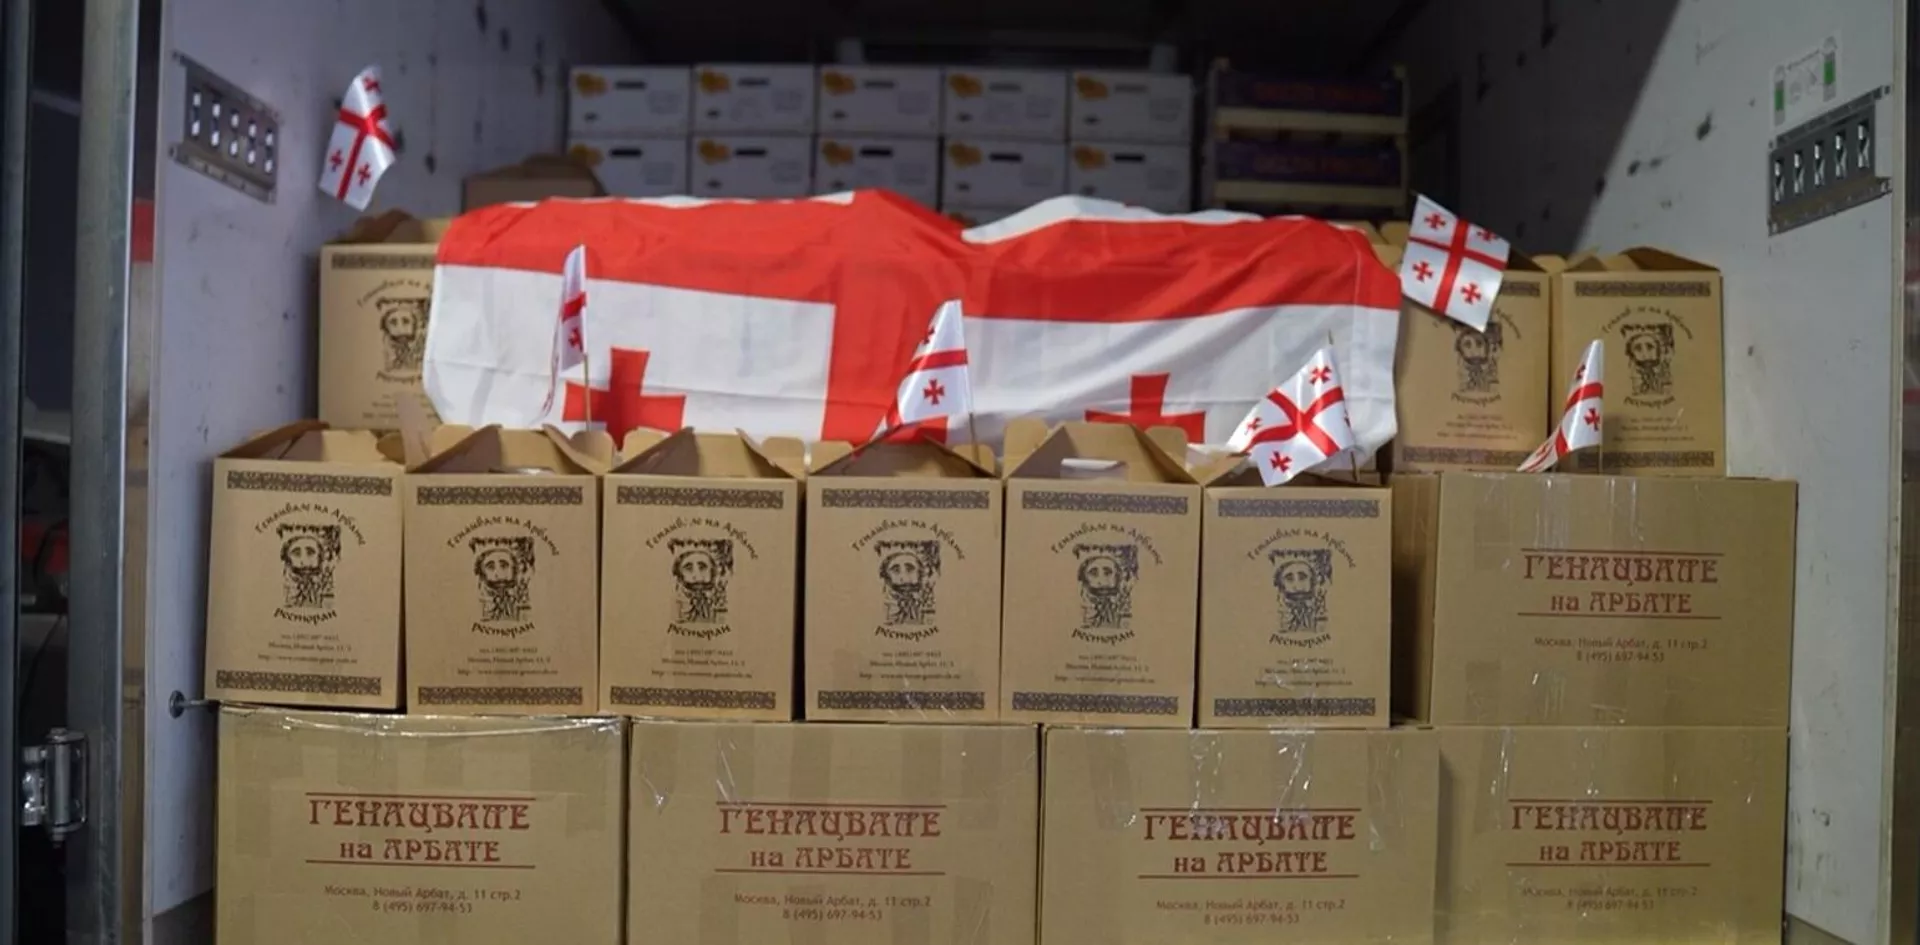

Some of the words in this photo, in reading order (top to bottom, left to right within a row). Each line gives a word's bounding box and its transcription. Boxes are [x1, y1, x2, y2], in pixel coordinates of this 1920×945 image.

[646, 517, 701, 548] Генацвле
[1524, 555, 1718, 586] ГЕНАЦВАЛЕ
[1551, 594, 1580, 611] на
[1590, 592, 1692, 614] АРБАТЕ
[308, 799, 531, 833] ГЕНАЦВАЛЕ
[719, 808, 941, 842] ГЕНАЦВАЛЕ
[1511, 805, 1708, 836] ГЕНАЦВАЛЕ
[1144, 814, 1356, 845] ГЕНАЦВАЛЕ
[339, 841, 373, 860] на
[383, 838, 501, 863] АРБАТЕ
[750, 849, 784, 867] на
[794, 846, 912, 869] АРБАТЕ
[1539, 844, 1570, 860] на
[1580, 841, 1681, 861] АРБАТЕ
[1174, 856, 1205, 873] на
[1216, 851, 1328, 873] АРБАТЕ
[374, 886, 412, 899] Новый
[415, 887, 454, 900] Арбат,
[457, 889, 468, 900] д.
[474, 889, 486, 899] 11
[784, 894, 823, 905] Новый
[826, 895, 864, 908] Арбат,
[885, 896, 896, 906] 11
[1303, 899, 1312, 909] 11
[383, 901, 413, 913] (495)
[416, 901, 472, 913] 697-94-53
[794, 909, 824, 921] (495)
